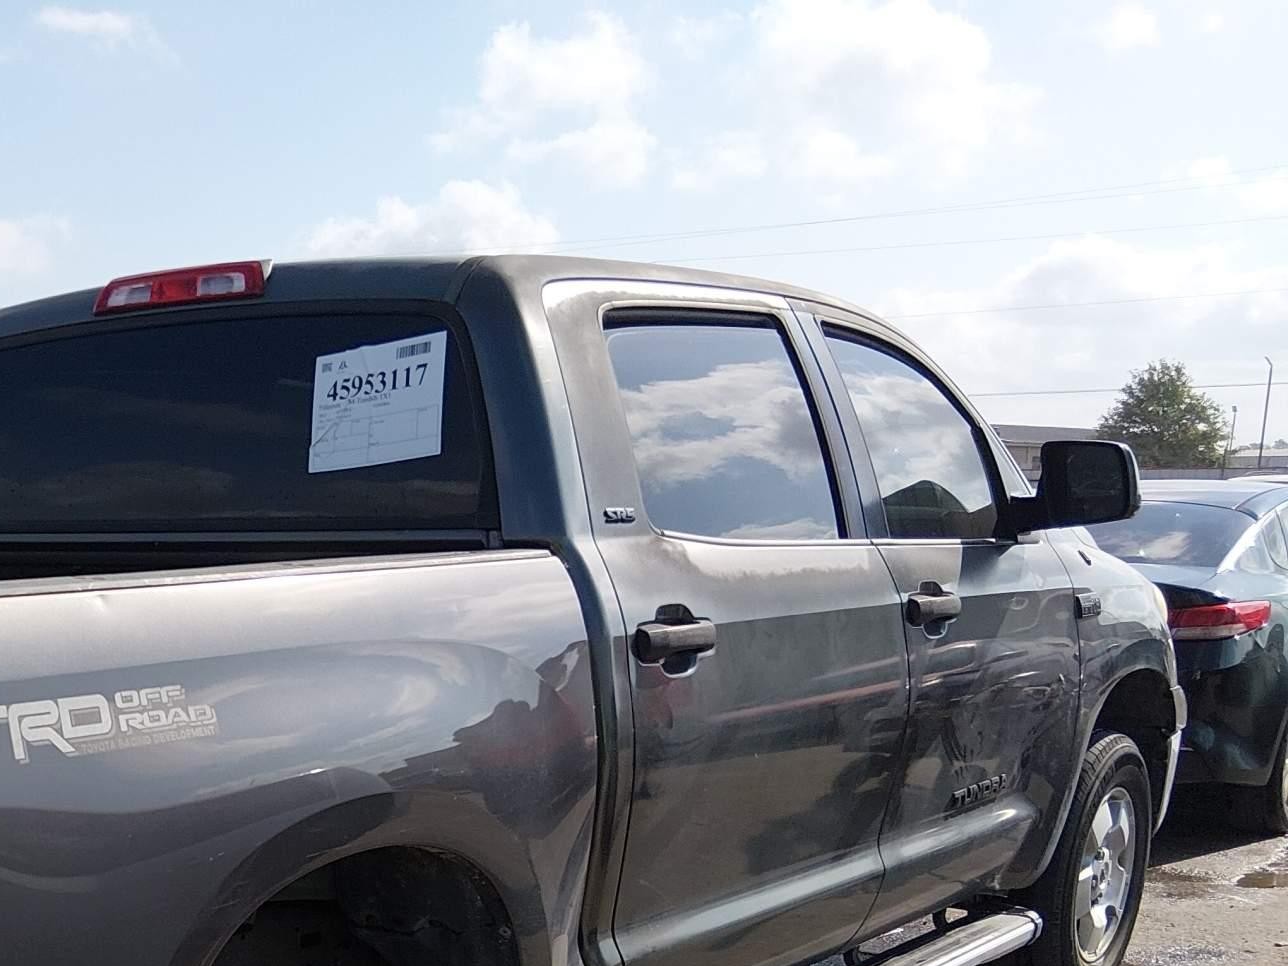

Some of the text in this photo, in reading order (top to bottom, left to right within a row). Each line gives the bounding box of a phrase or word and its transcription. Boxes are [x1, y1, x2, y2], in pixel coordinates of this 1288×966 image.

[326, 362, 428, 402] 45953117
[114, 684, 186, 709] OFF
[117, 703, 217, 733] ROAD
[952, 773, 1009, 809] TUNDRA
